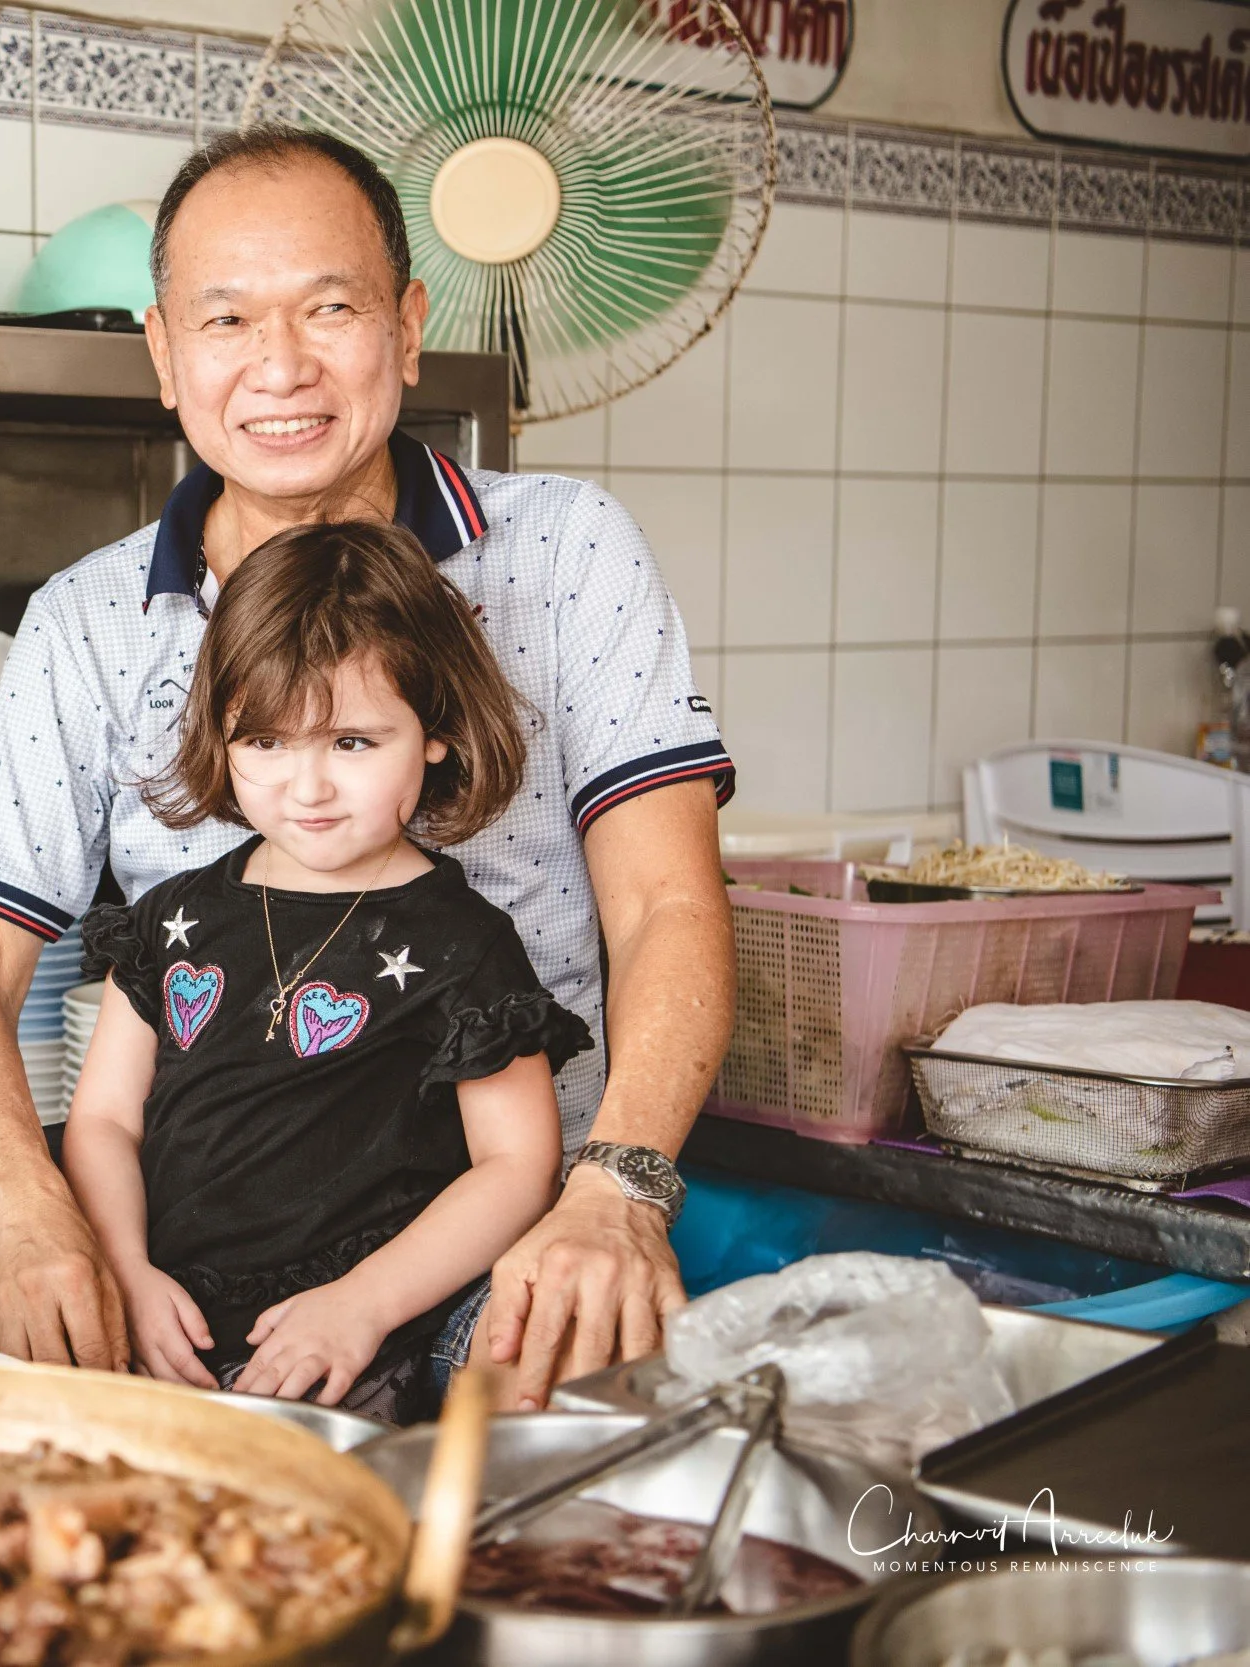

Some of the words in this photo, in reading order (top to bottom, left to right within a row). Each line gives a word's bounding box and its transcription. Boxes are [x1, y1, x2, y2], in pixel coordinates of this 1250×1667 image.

[149, 698, 175, 709] LOOK
[170, 973, 218, 990] MERMAID
[301, 991, 360, 1015] MERMAID
